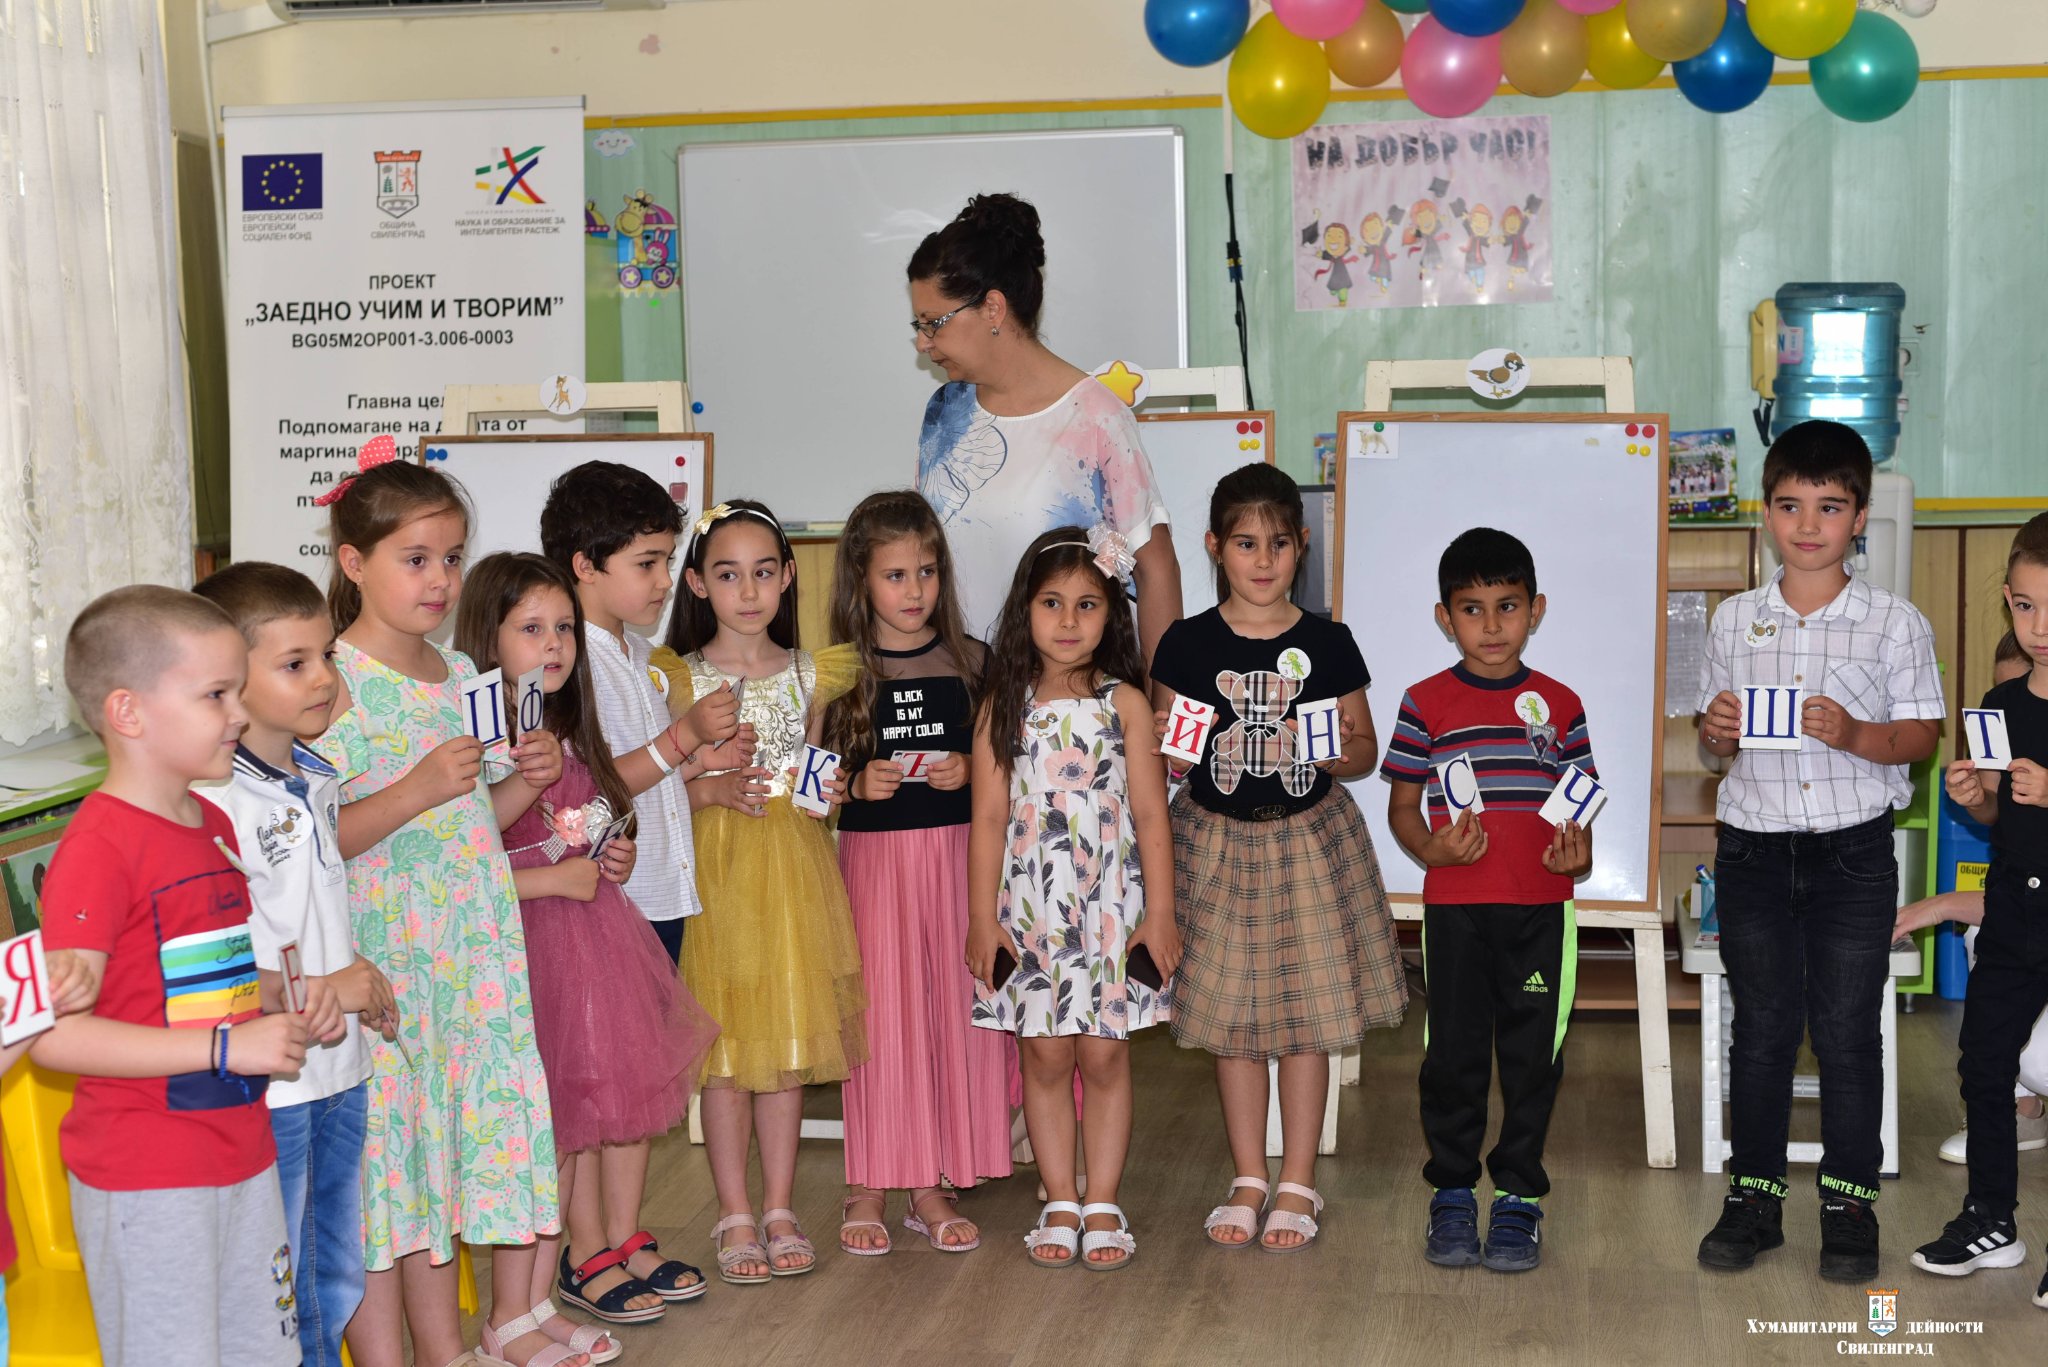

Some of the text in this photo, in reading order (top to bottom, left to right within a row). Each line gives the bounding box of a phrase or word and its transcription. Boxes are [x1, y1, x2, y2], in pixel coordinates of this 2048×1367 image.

[242, 212, 323, 222] ЕВРОПЕЙСКИ СЪЮЗ
[483, 218, 490, 226] И
[491, 217, 552, 225] ОБРАЗОВАНИЕ
[554, 216, 566, 225] ЗА
[242, 223, 296, 232] ЕВРОПЕЙСКИ
[379, 221, 416, 229] ОБЩИНА
[460, 226, 560, 236] ИНТЕЛИГЕНТЕН РАСТЕЖ
[242, 232, 312, 242] СОЦИАЛЕН ФОНД
[370, 230, 426, 239] СВИЛЕНГРАД
[369, 274, 436, 289] ПРОЕКТ
[359, 299, 422, 320] УЧИМ
[431, 299, 446, 319] И
[347, 394, 411, 409] Главна
[279, 419, 402, 436] Подпомагане
[408, 421, 430, 433] на
[507, 419, 527, 432] от
[310, 471, 333, 485] да
[893, 689, 923, 703] BLACK
[520, 680, 543, 733] Ф
[896, 707, 923, 721] IS MY
[1742, 687, 1800, 739] Ш
[1031, 711, 1039, 722] 6
[882, 722, 945, 740] HAPPY COLOR
[1166, 700, 1208, 756] Й
[1301, 708, 1340, 763] Н
[1965, 710, 2001, 760] Т
[796, 745, 836, 804] К
[1445, 756, 1477, 810] С
[1564, 765, 1604, 824] Ч
[1960, 864, 1989, 875] ОБЩИ
[4, 934, 48, 1027] Я
[1523, 985, 1548, 993] adidas
[1739, 1175, 1770, 1192] WHITE
[1769, 1182, 1789, 1199] BLA
[1821, 1174, 1854, 1194] WHITE
